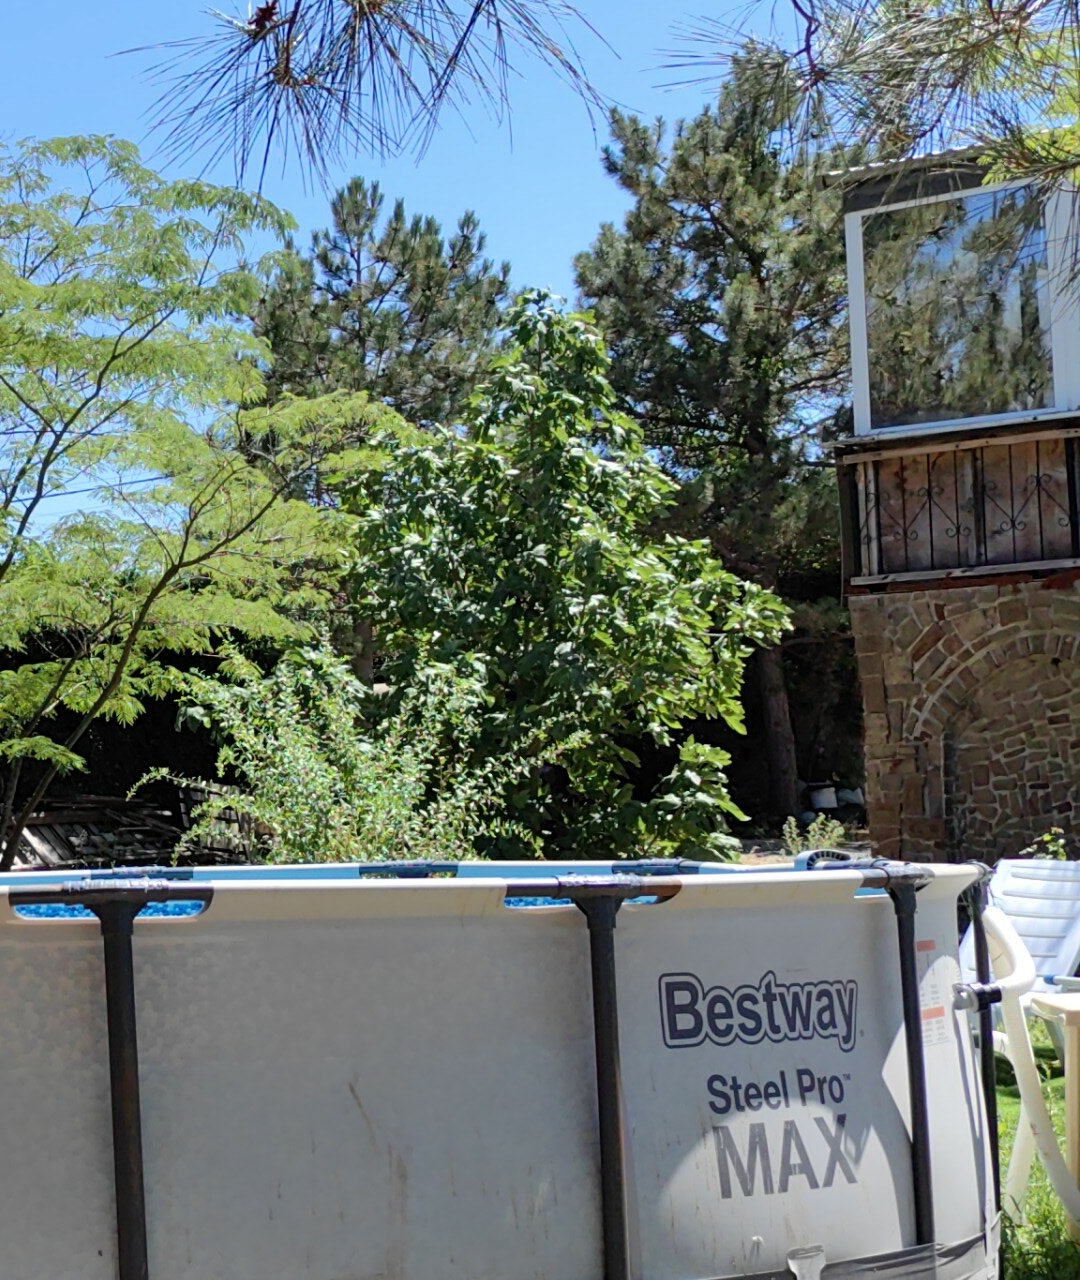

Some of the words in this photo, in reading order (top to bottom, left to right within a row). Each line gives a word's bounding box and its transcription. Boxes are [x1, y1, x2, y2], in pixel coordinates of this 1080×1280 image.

[660, 972, 857, 1049] Bestway
[706, 1070, 790, 1114] Steel
[712, 1113, 858, 1199] MAX
